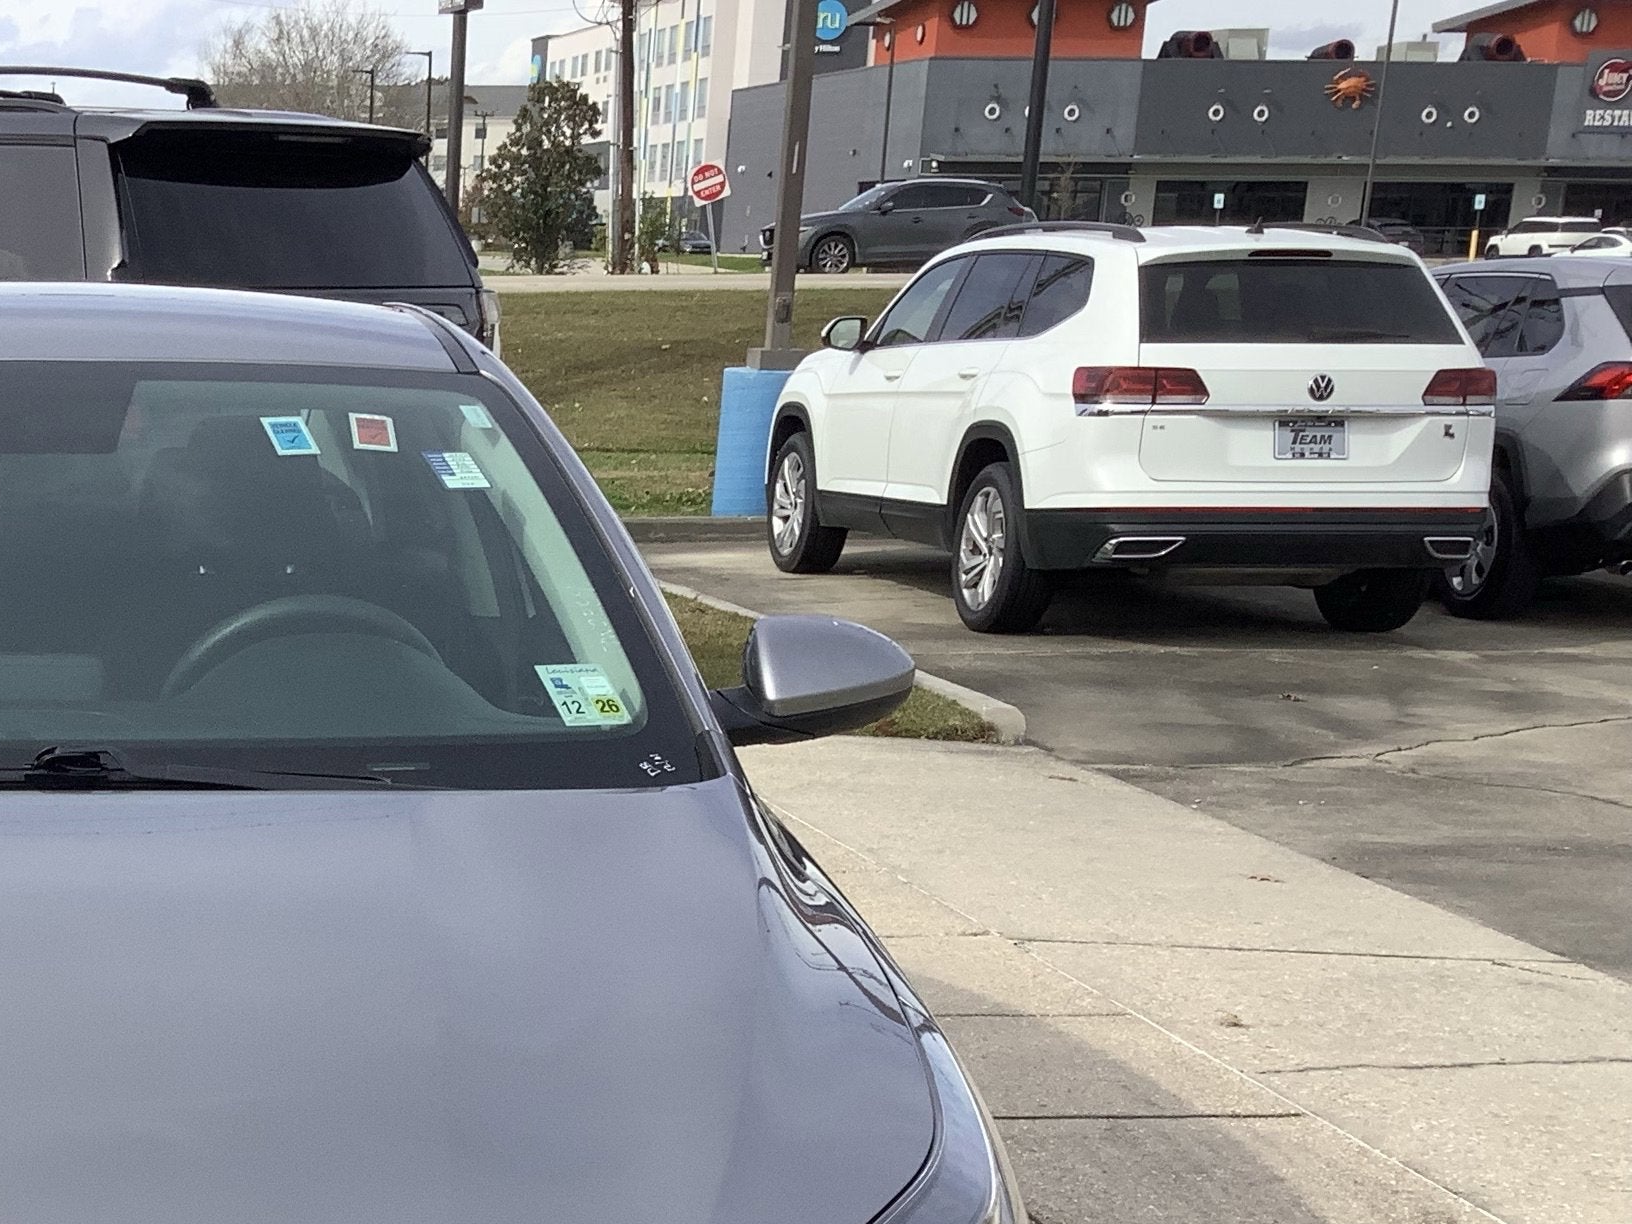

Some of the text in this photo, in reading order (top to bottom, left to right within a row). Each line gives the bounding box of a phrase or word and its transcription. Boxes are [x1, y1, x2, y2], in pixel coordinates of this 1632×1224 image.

[817, 12, 840, 29] ru
[1584, 109, 1632, 126] RESTA
[693, 168, 719, 182] DO NOT
[1289, 428, 1334, 446] TEAM
[561, 699, 620, 715] 12 26
